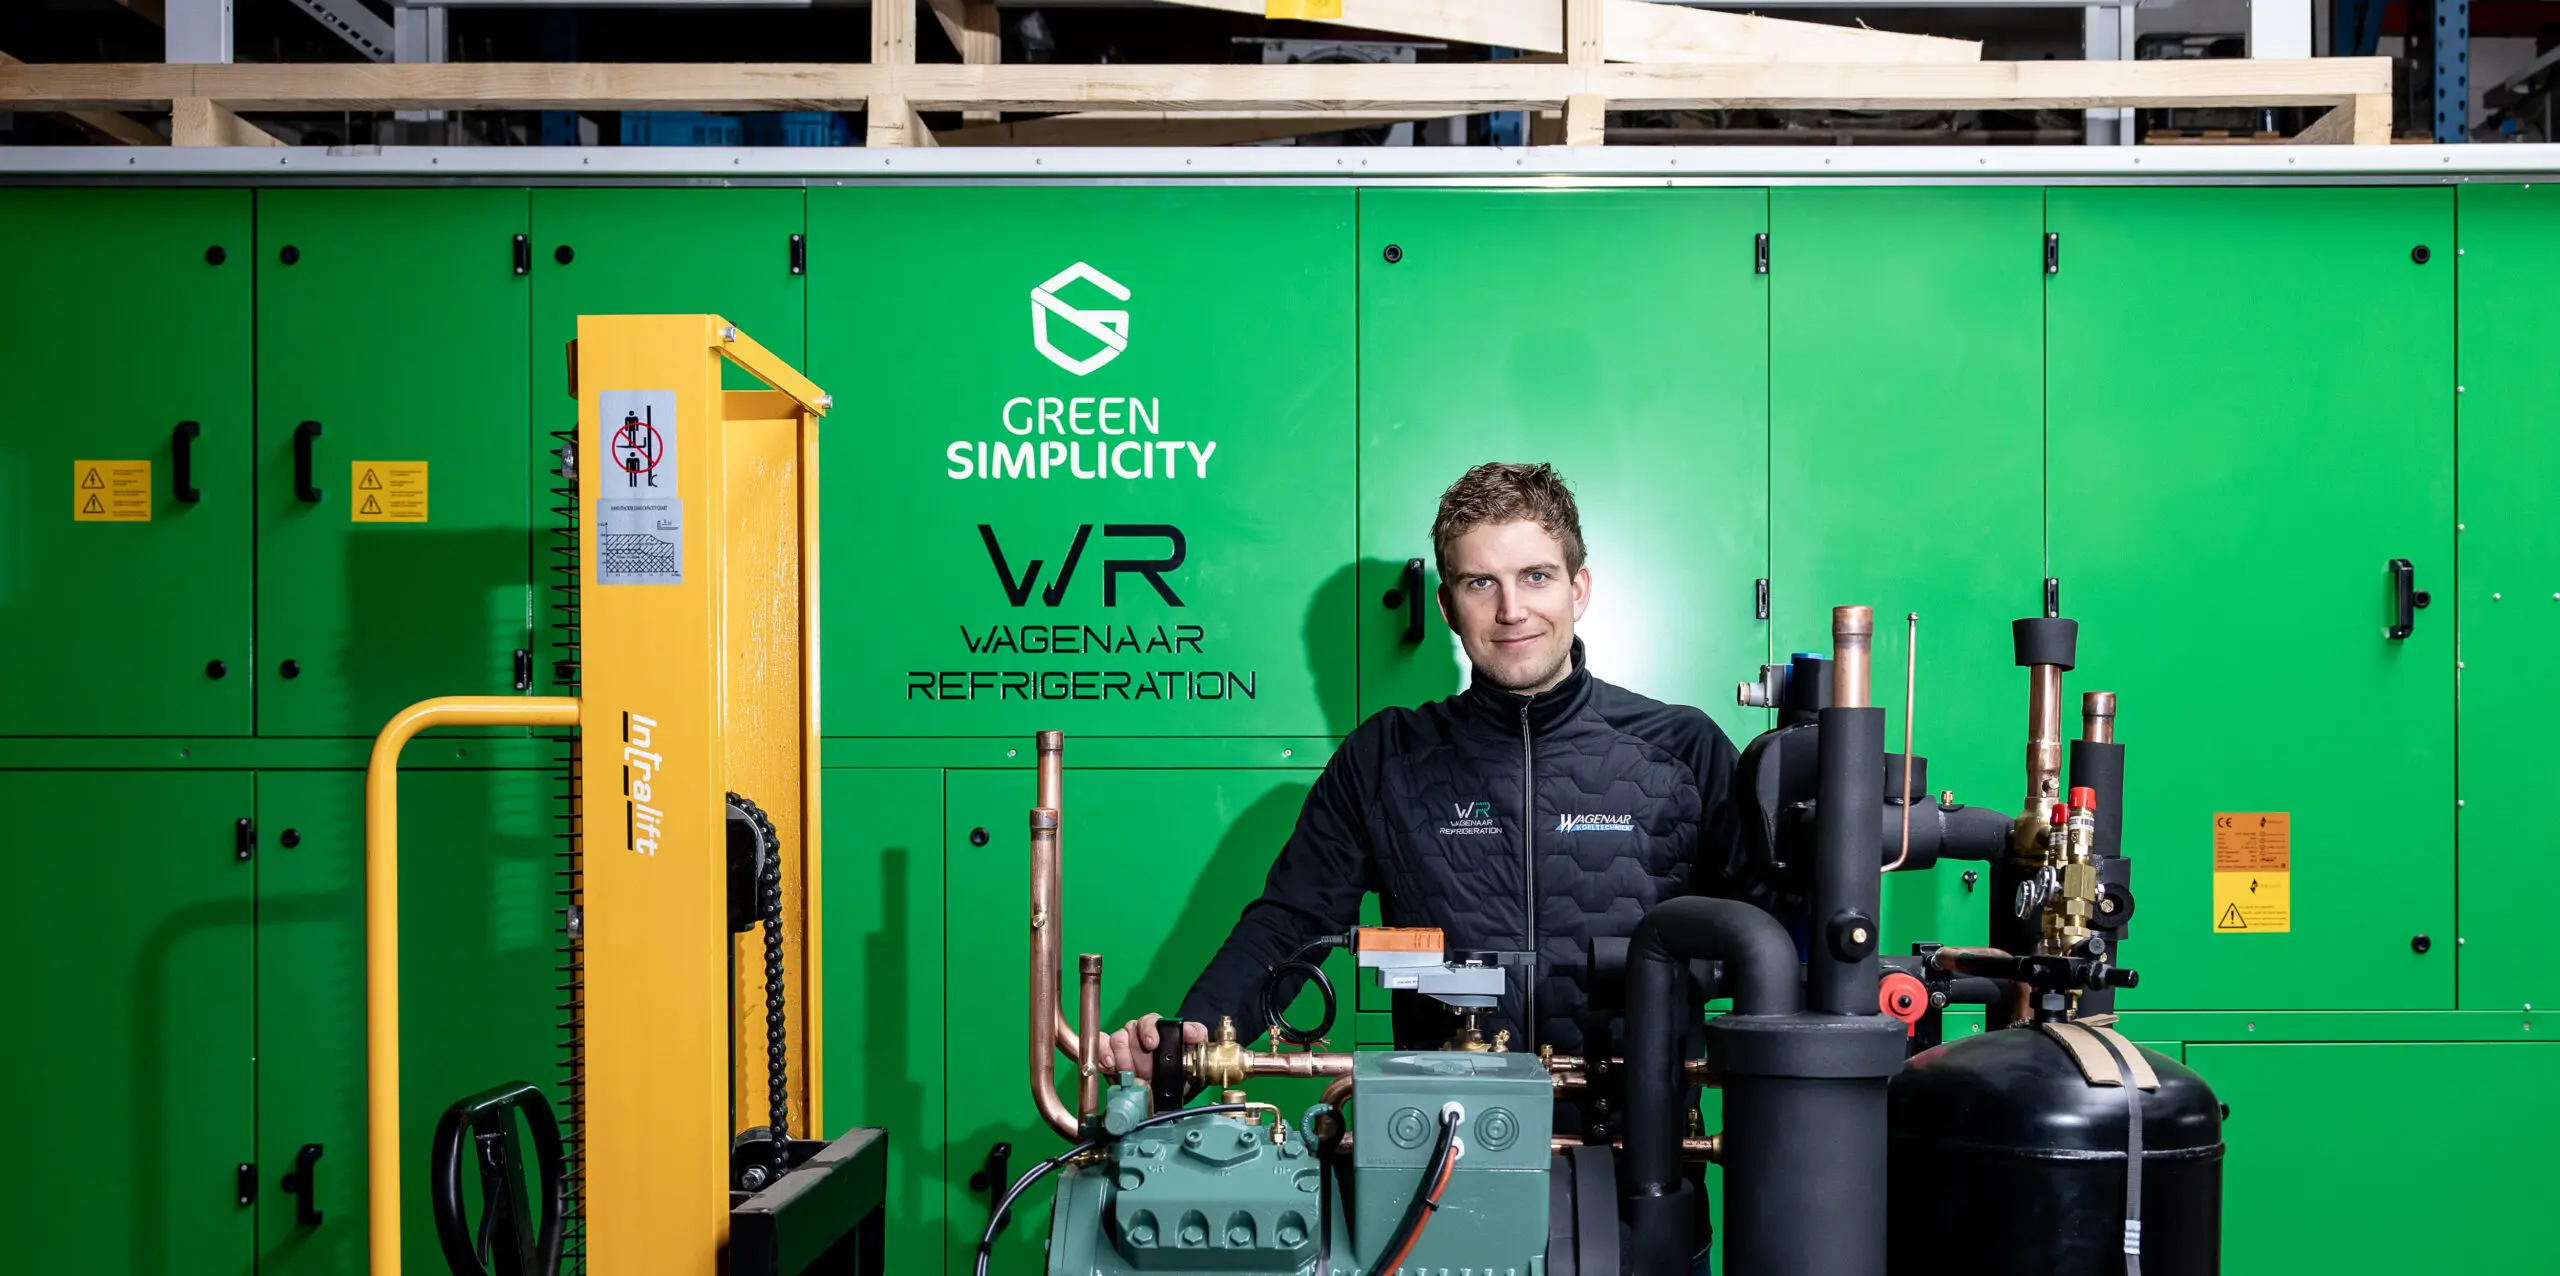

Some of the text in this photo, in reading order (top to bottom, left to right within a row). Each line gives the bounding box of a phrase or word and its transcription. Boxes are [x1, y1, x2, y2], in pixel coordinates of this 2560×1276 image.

[1002, 397, 1159, 435] GREEN
[946, 440, 1217, 479] SIMPLICITY
[977, 524, 1187, 607] WR
[960, 625, 1204, 654] WAGENAAR
[906, 671, 1256, 700] REFRIGERATION
[624, 713, 664, 857] Intralift
[1450, 819, 1493, 827] WAGENAAR
[1454, 802, 1491, 819] WR
[1560, 814, 1632, 833] WAGENAAR
[1439, 827, 1502, 835] REFRIGERATION
